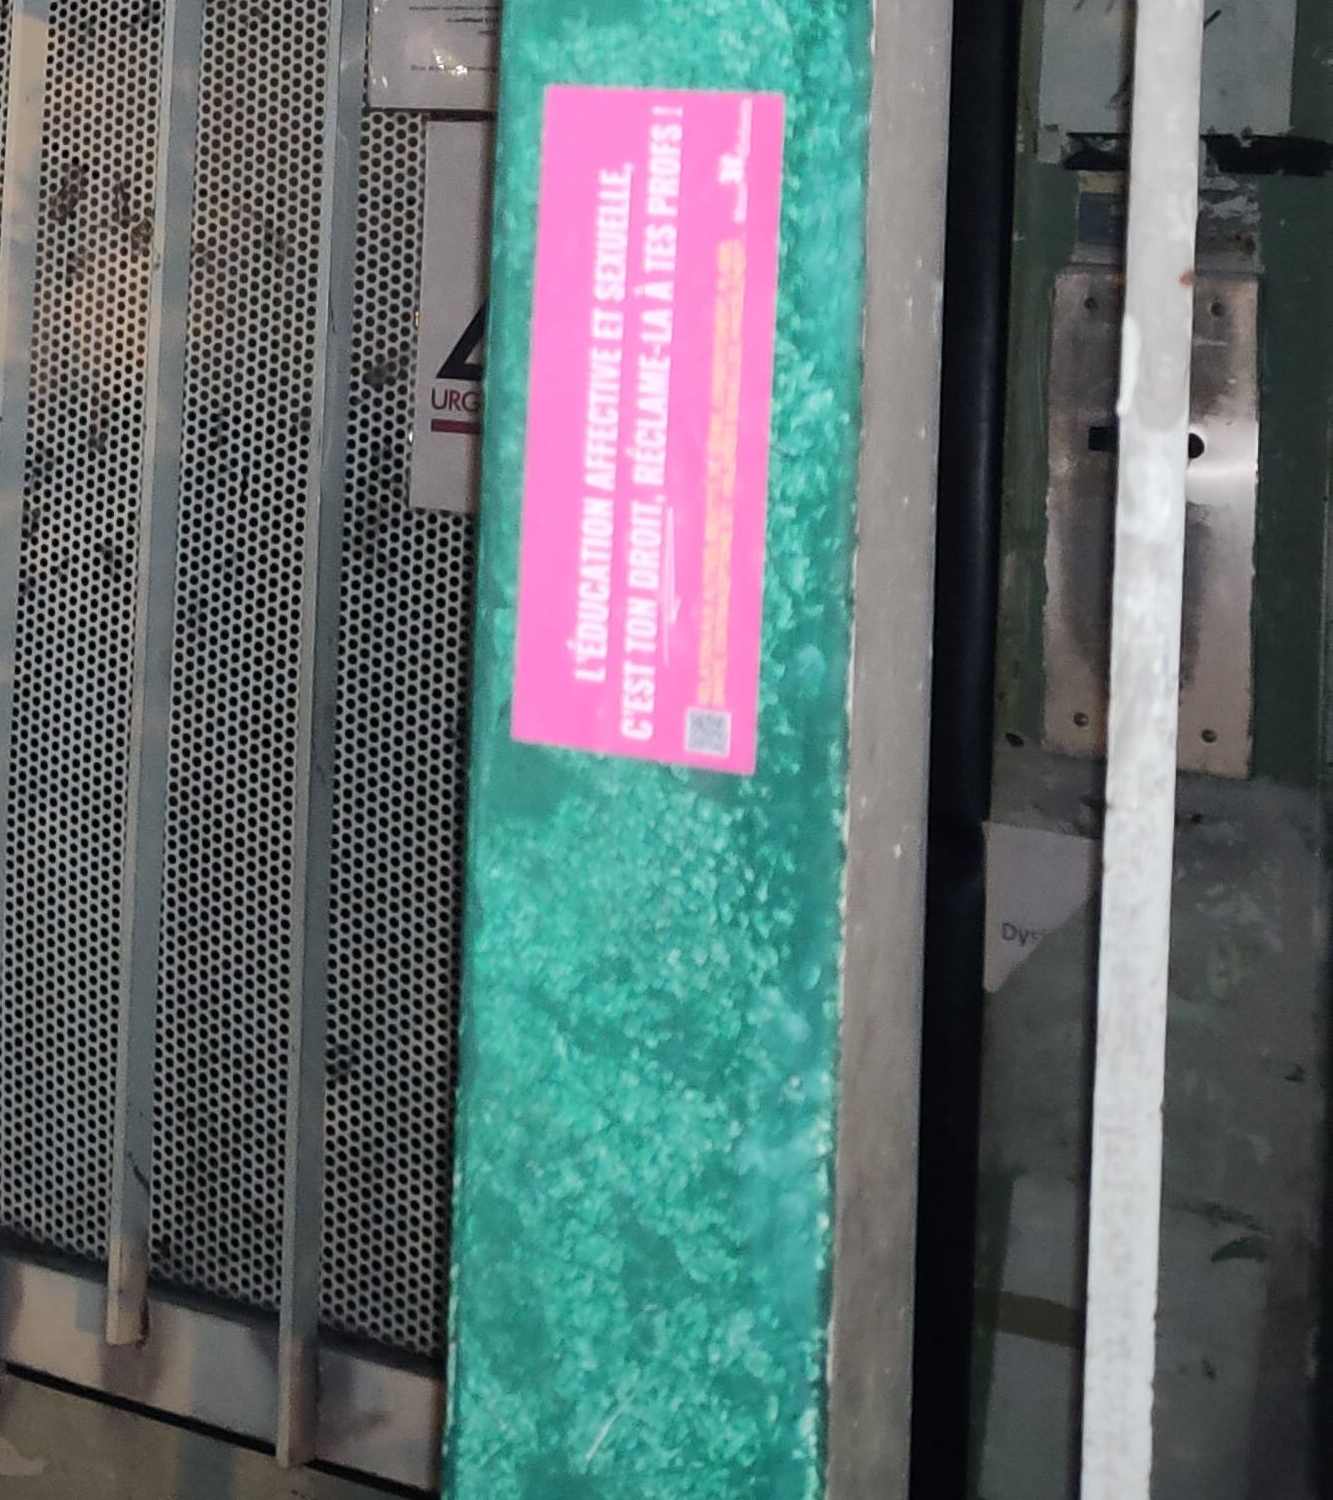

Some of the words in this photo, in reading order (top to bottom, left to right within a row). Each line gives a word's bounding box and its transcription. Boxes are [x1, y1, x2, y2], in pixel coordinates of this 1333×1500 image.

[652, 106, 685, 117] !
[646, 124, 684, 215] PROFS
[592, 162, 634, 301] SEXUELLE,
[643, 223, 678, 272] TES
[590, 308, 622, 340] ET
[633, 280, 676, 300] À
[584, 347, 621, 491] AFFECTIVE
[626, 308, 673, 486] RÉCLAME-LA
[628, 494, 665, 589] DROIT,
[567, 498, 613, 682] L'ÉDUCATION
[625, 599, 659, 653] TON
[621, 662, 655, 740] C'EST
